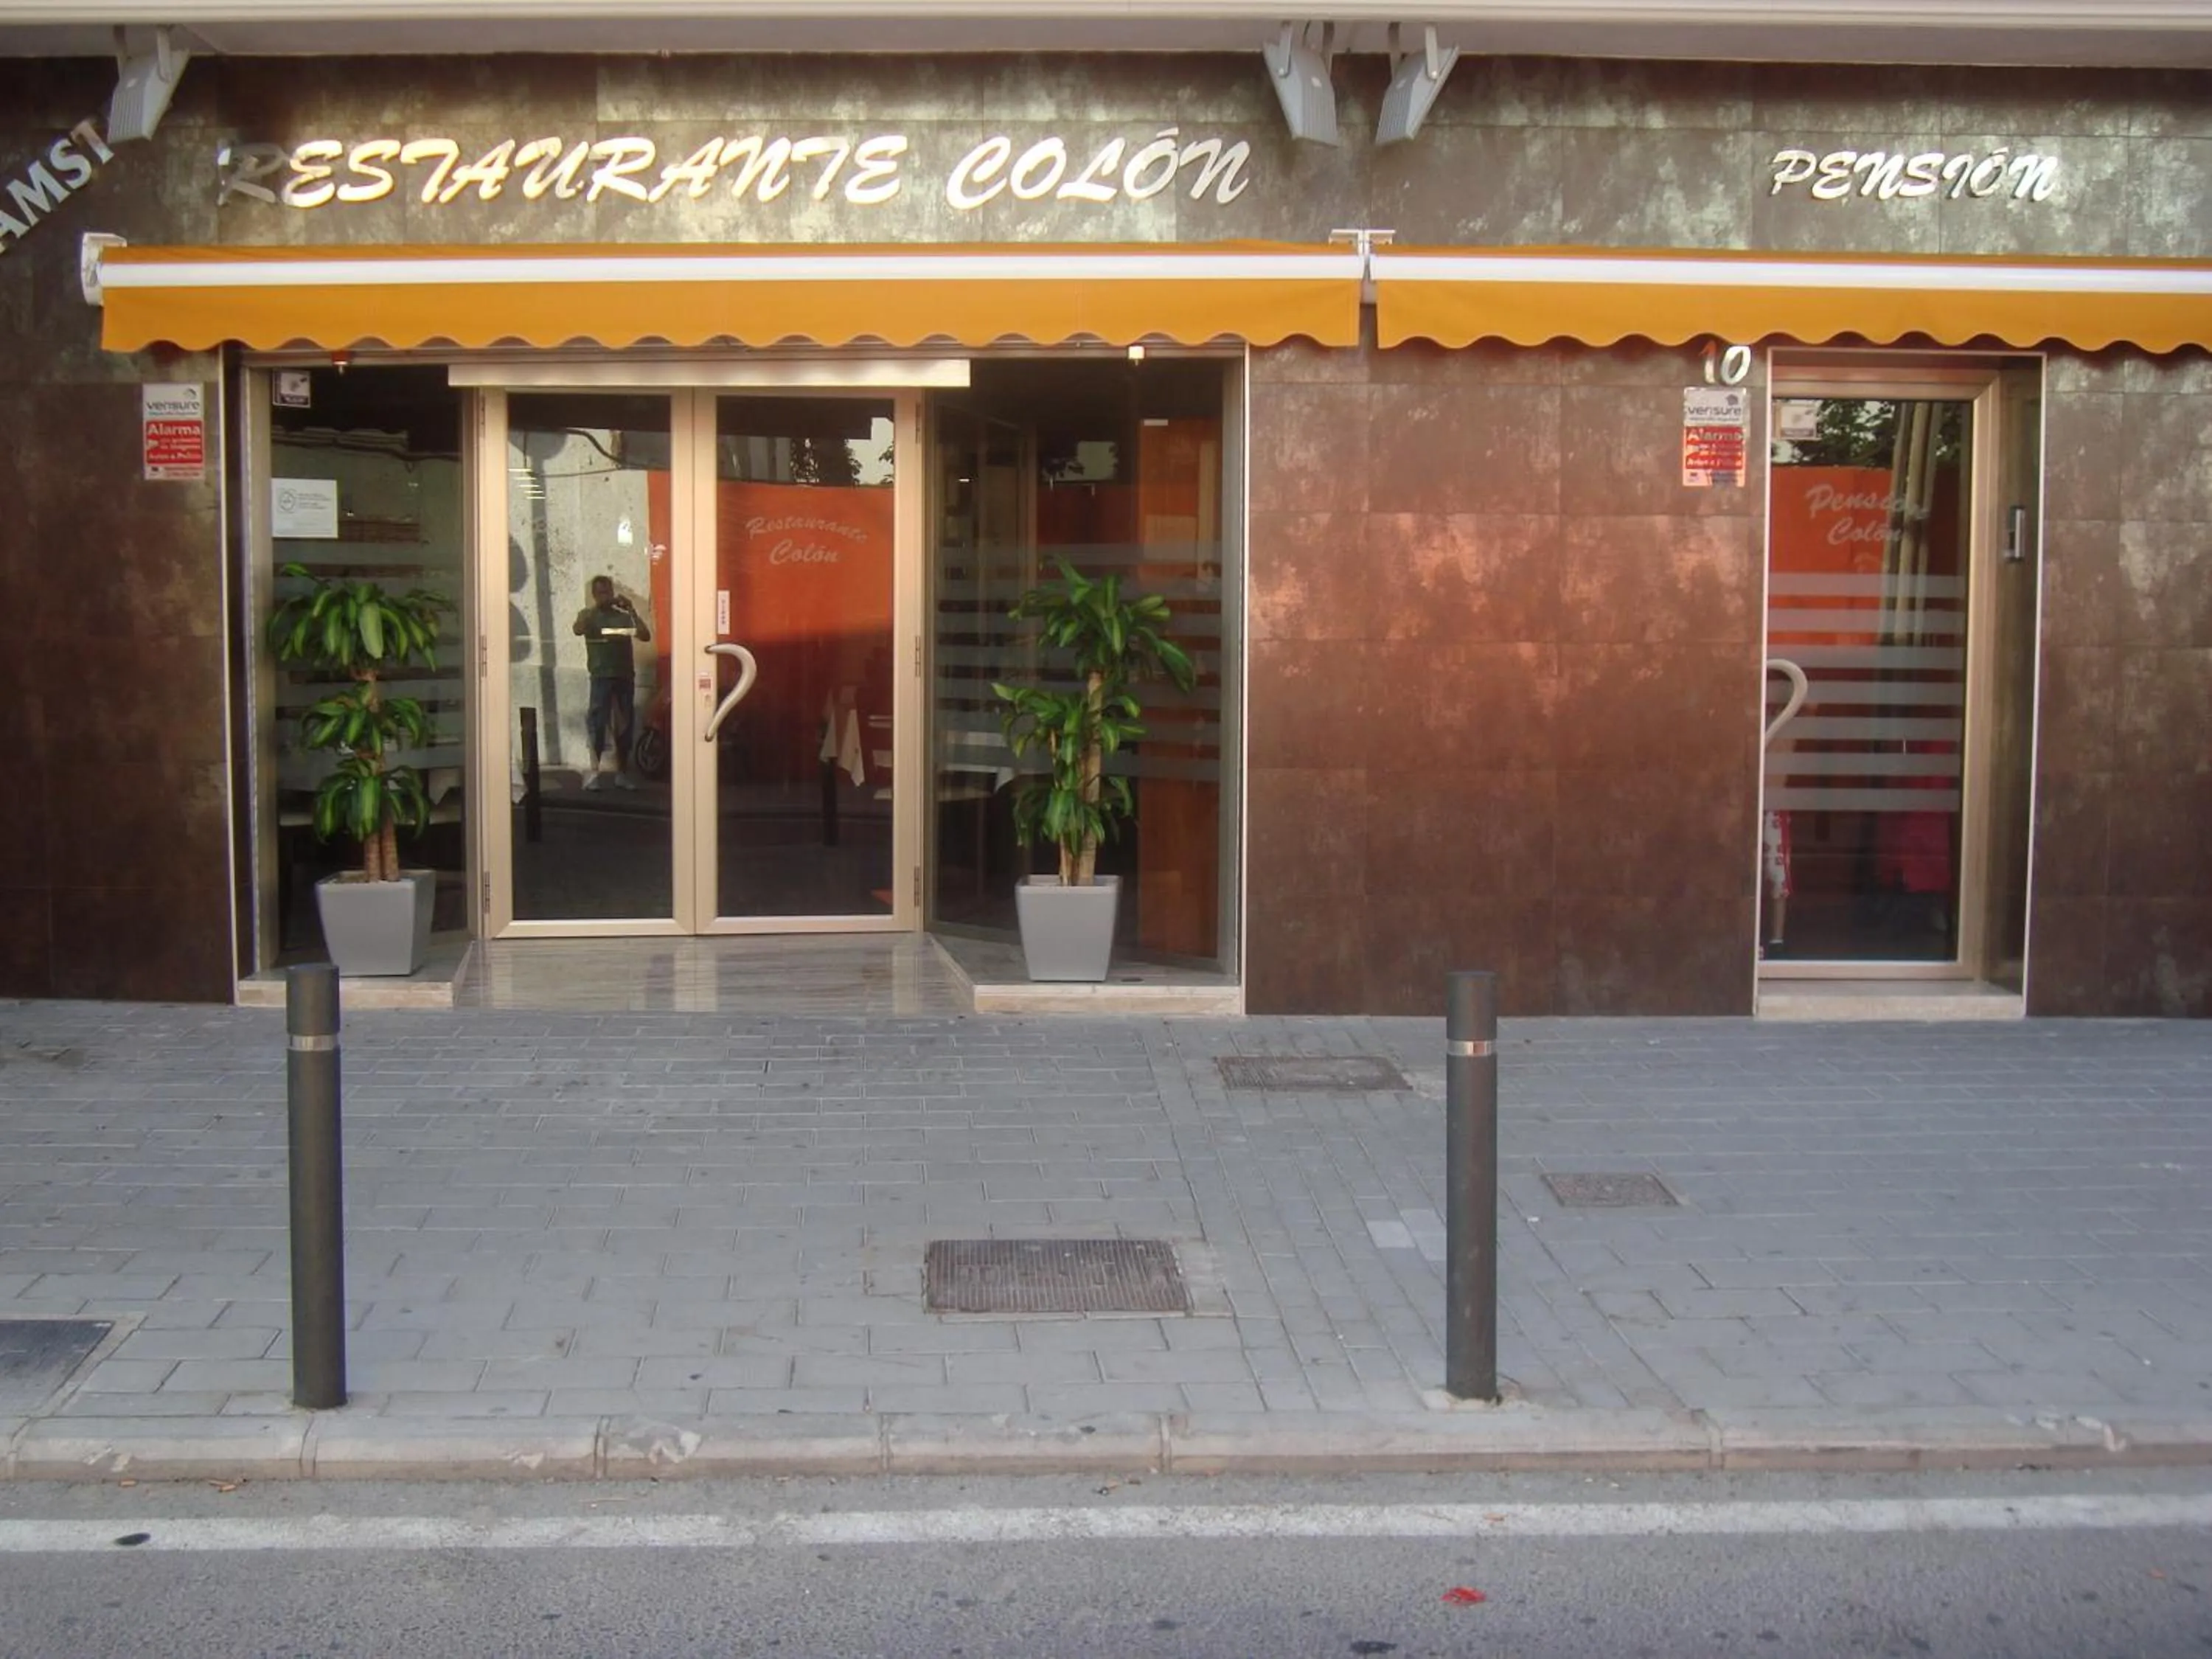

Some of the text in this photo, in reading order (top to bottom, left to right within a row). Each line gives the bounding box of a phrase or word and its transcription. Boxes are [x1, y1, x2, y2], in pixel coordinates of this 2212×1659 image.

[217, 128, 1251, 209] RESTAURANTE COLÓN
[1770, 147, 2059, 201] PENSIÓN
[1699, 340, 1751, 386] 10
[147, 422, 201, 435] Alarma
[745, 515, 868, 544] Restaurante
[769, 538, 839, 566] Colón
